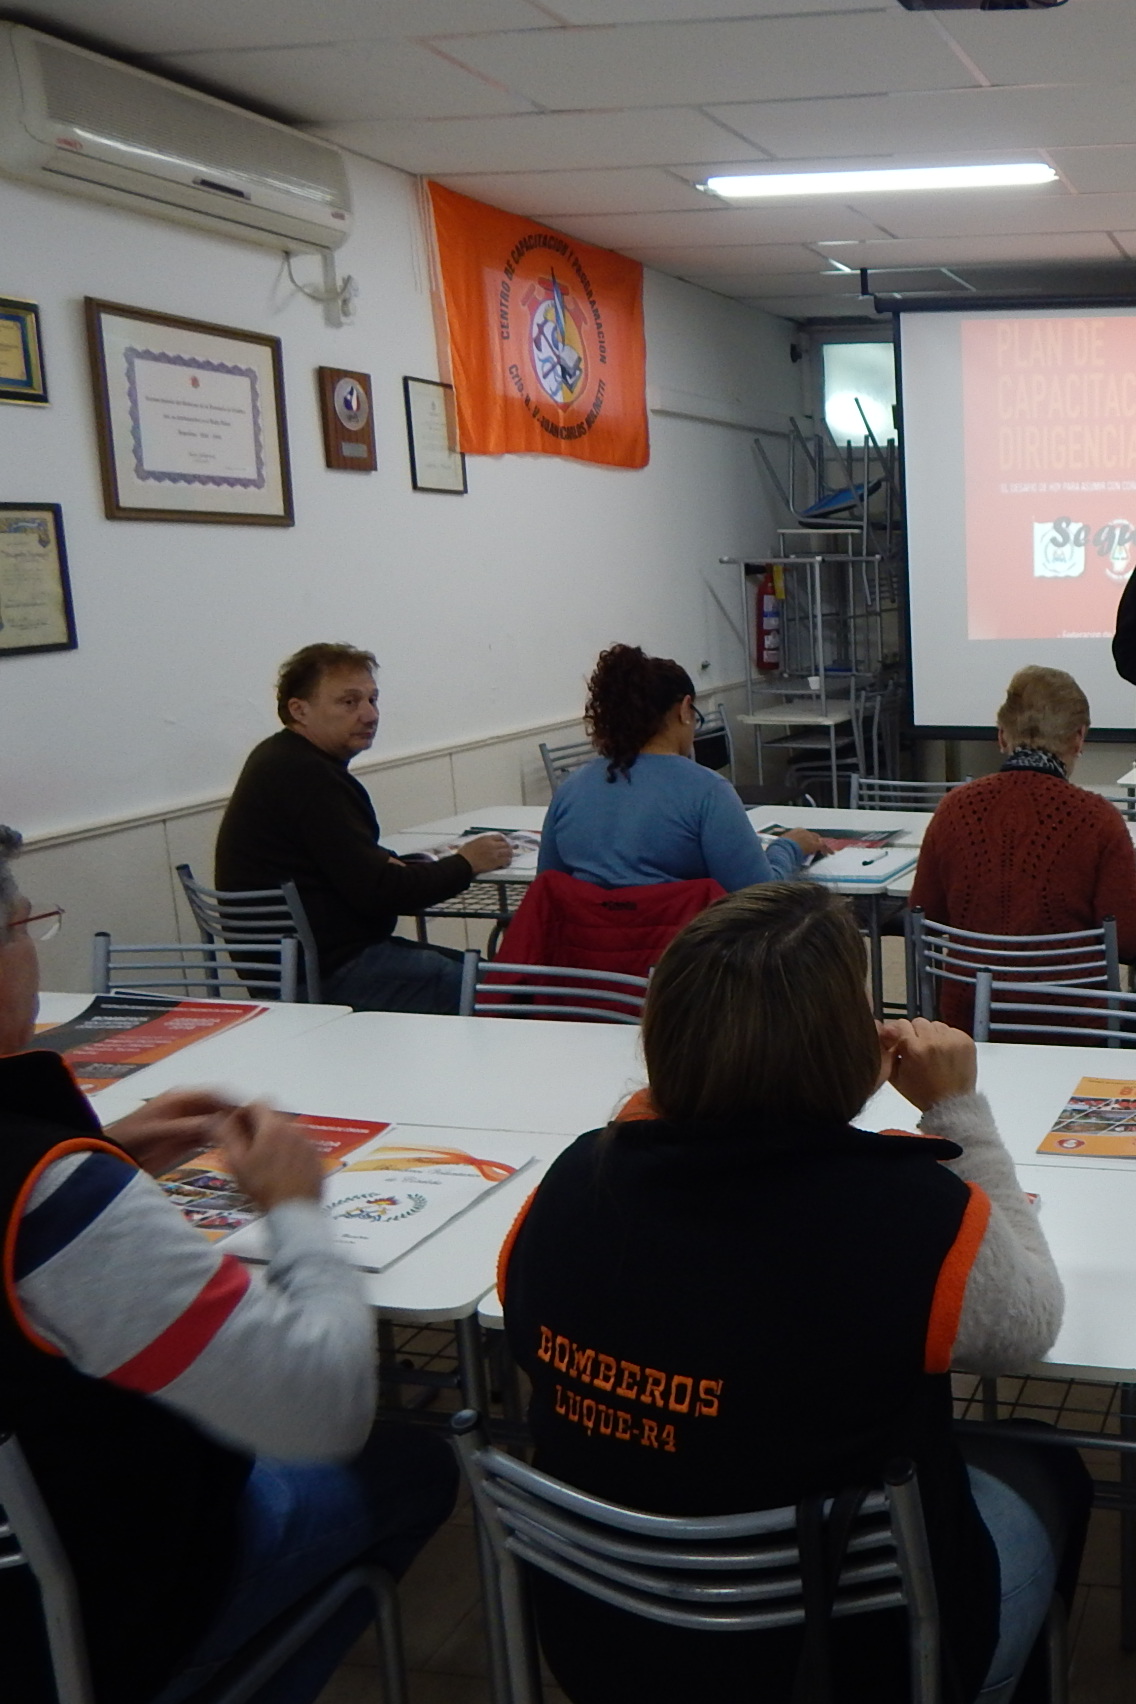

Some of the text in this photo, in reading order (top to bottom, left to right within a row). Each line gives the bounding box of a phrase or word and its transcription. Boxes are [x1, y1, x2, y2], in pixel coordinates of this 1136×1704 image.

[504, 260, 516, 281] DE
[511, 233, 570, 266] CAPACITACION
[500, 280, 511, 340] CENTRO
[571, 257, 607, 365] PROGRAMACION
[996, 320, 1105, 368] PLAN DE
[537, 1325, 724, 1417] BOMBEROS
[556, 1384, 676, 1452] LUQUE-R4
